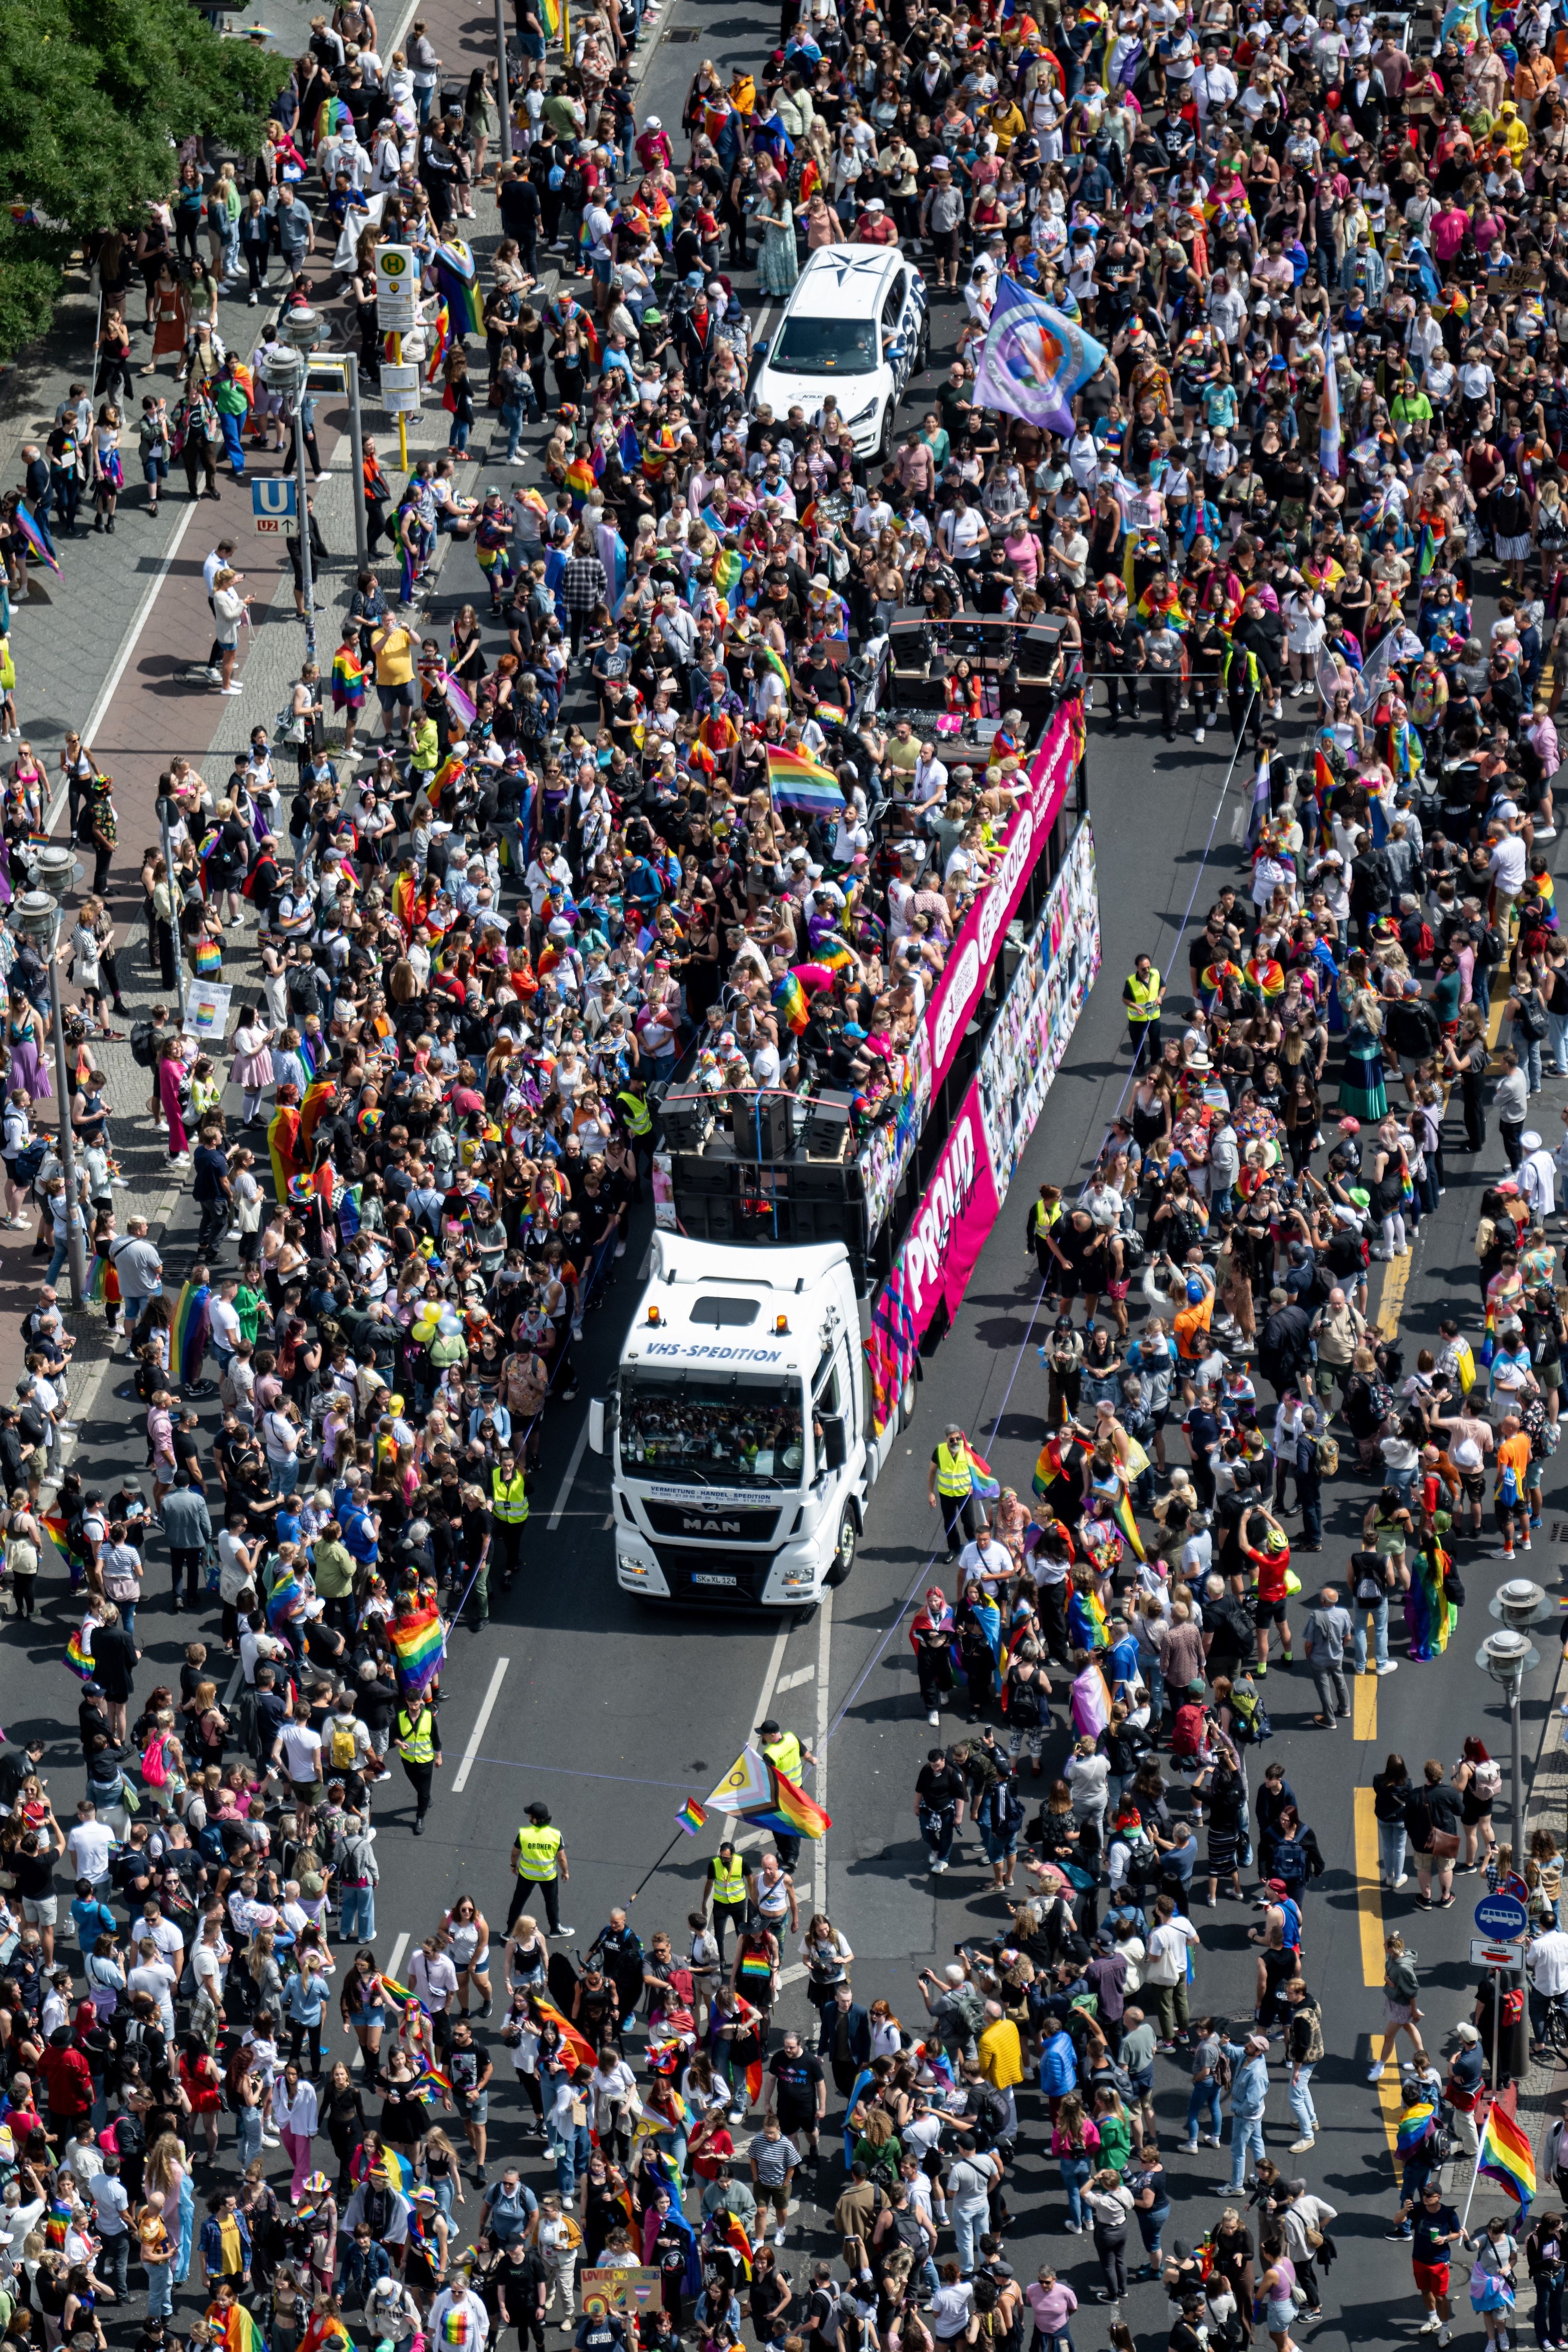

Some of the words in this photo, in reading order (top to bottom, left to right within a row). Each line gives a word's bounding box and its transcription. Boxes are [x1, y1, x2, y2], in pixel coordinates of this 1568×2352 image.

[260, 482, 288, 513] U
[260, 521, 276, 530] U2
[1004, 823, 1027, 893] VOICE
[982, 910, 990, 954] BE
[908, 1117, 974, 1313] PROUD
[651, 1486, 695, 1495] VERMIETUNG
[683, 1518, 740, 1533] MAN
[582, 2270, 603, 2282] LOVE
